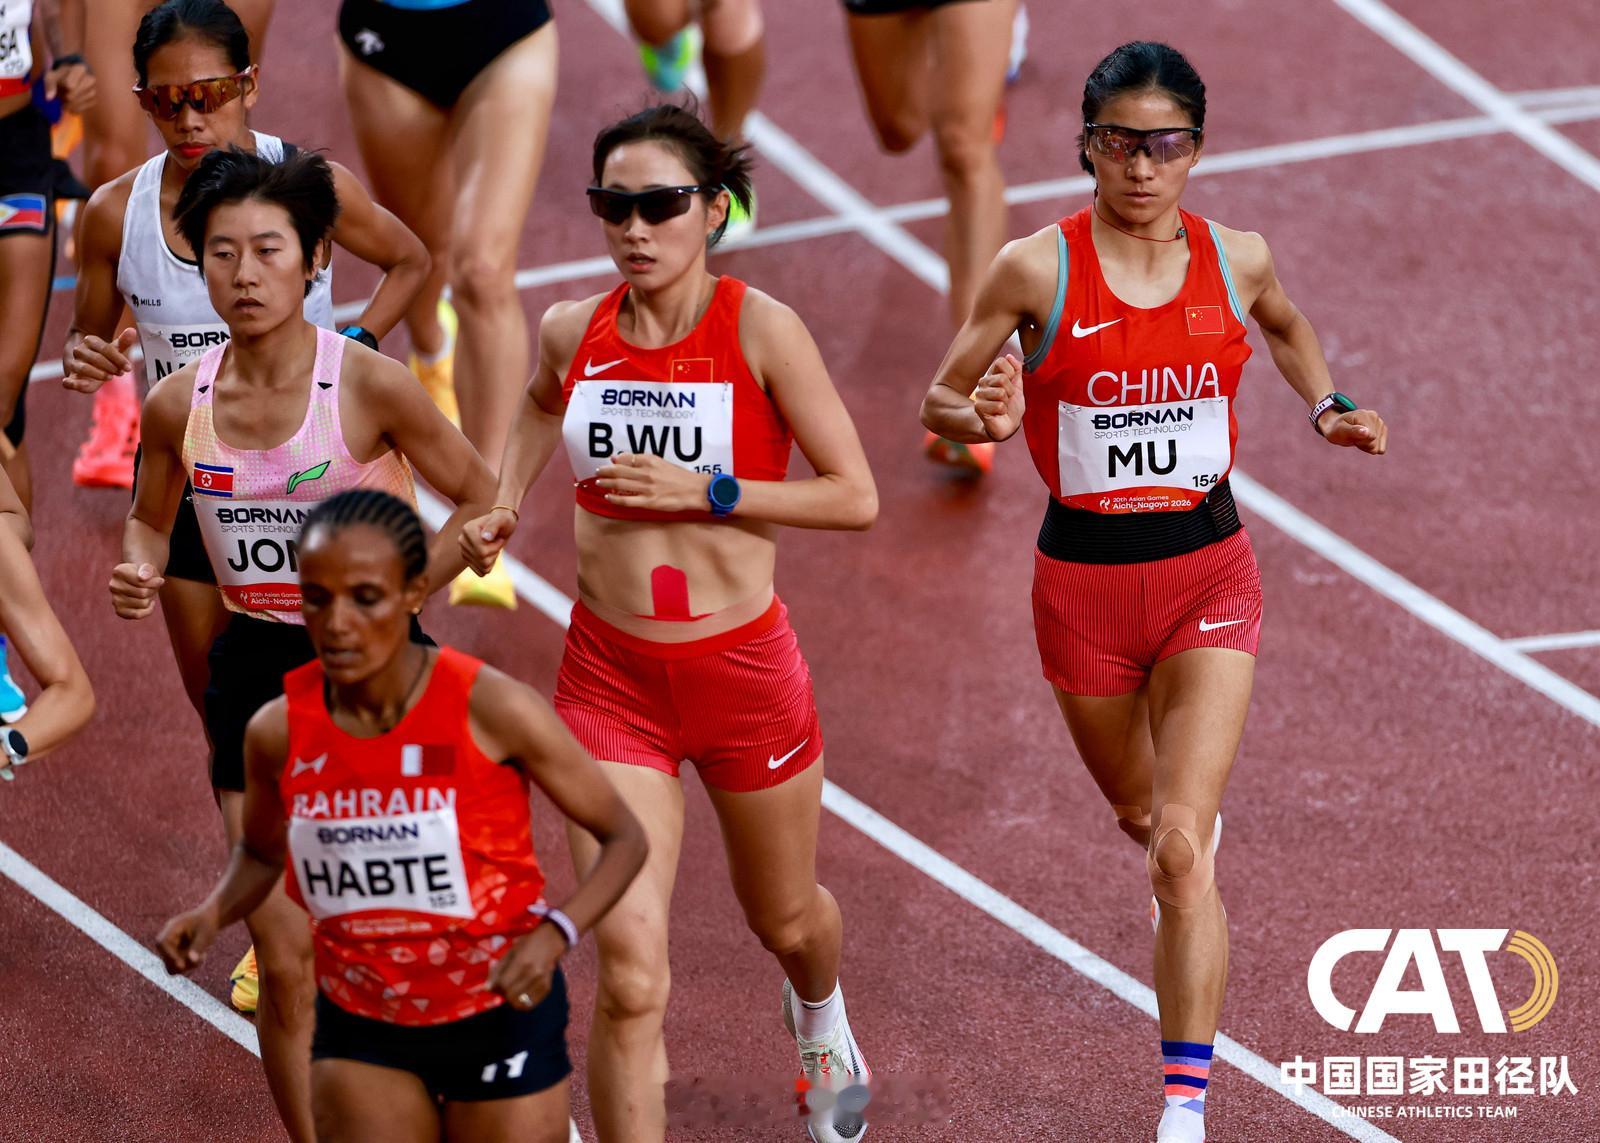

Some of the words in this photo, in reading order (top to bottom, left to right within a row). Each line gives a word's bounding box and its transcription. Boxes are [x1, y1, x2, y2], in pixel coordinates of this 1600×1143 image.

[140, 298, 162, 307] MILLS
[1087, 362, 1220, 405] CHINA
[601, 389, 695, 408] BORNAN
[600, 407, 633, 417] SPORTS
[636, 408, 695, 419] TECHNOLOGY
[1090, 406, 1193, 430] BORNAN
[1094, 429, 1129, 440] SPORTS
[1133, 423, 1193, 436] TECHNOLOGY
[1108, 439, 1177, 478] MU
[1192, 473, 1219, 488] 154
[1113, 501, 1169, 510] Aichi-Nagoya
[221, 525, 256, 533] SPORTS
[317, 823, 419, 845] BORNAN
[303, 854, 453, 897] HABTE
